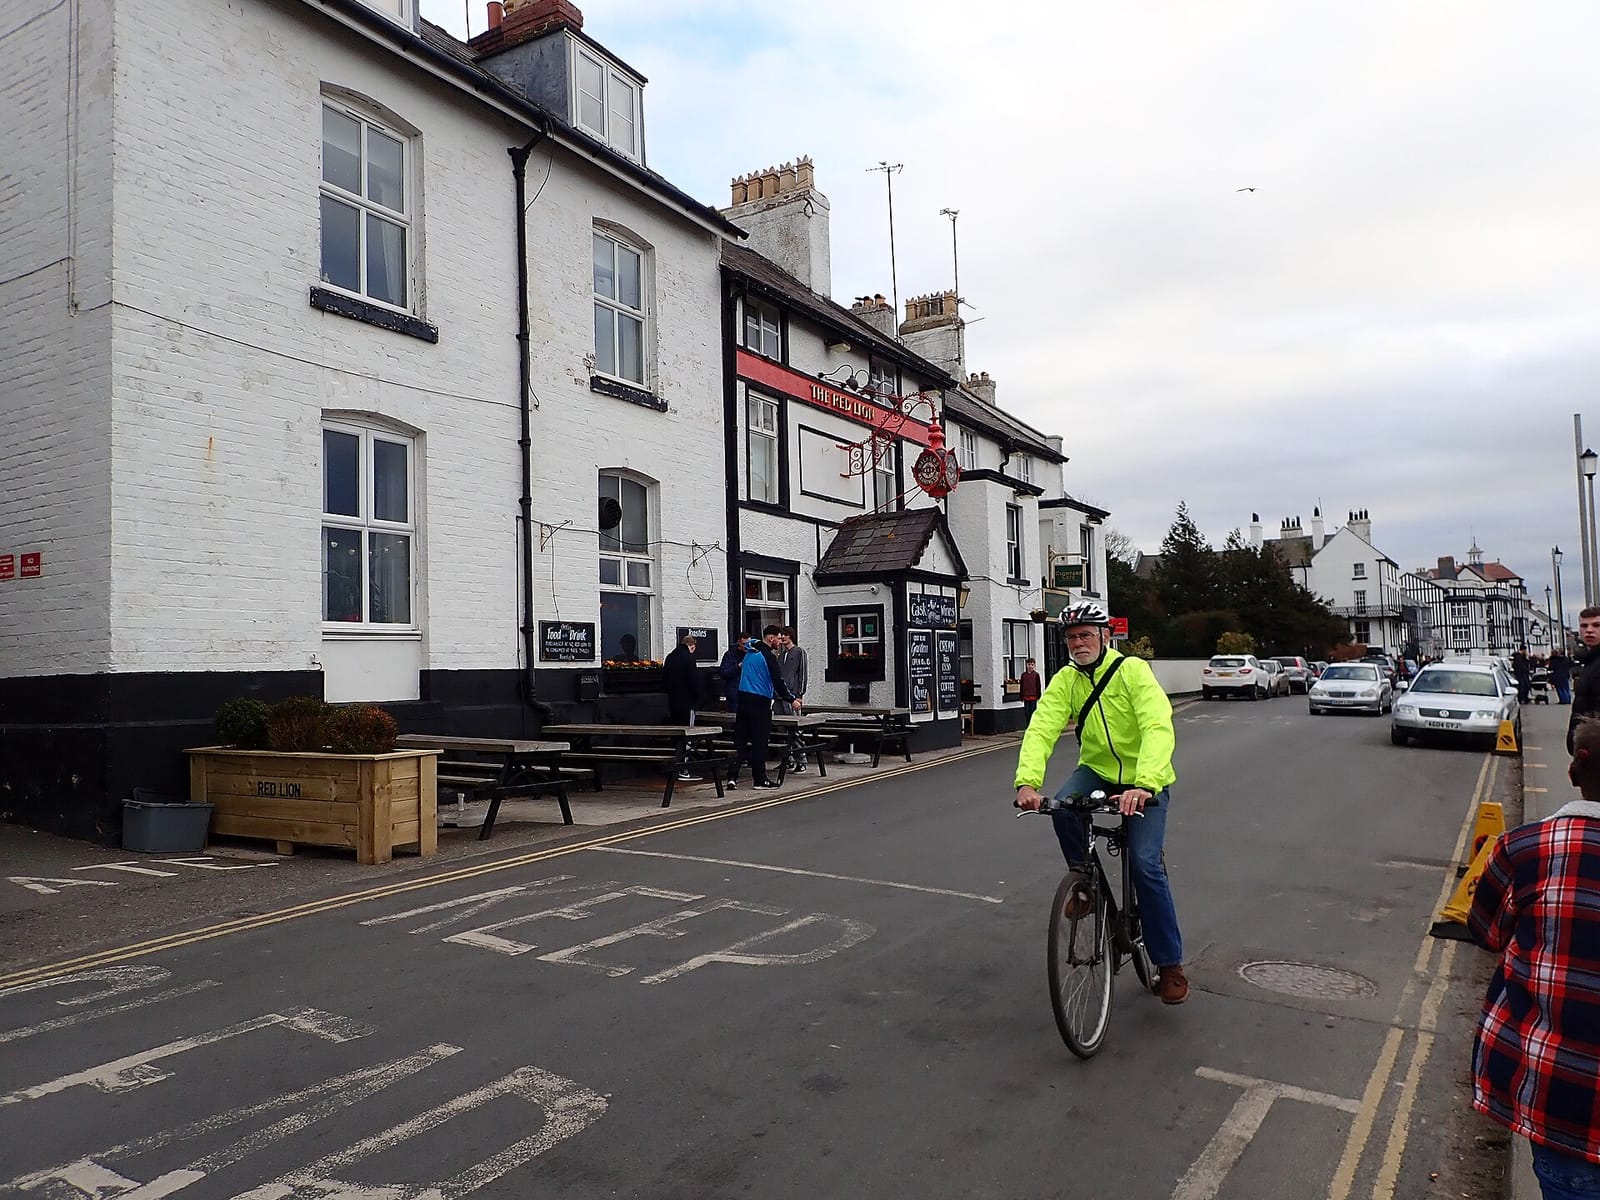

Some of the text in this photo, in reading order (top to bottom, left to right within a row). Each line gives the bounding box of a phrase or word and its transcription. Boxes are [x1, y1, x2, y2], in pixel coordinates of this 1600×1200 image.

[810, 384, 875, 420] THE RED LION
[547, 626, 587, 641] Food Drink
[939, 640, 955, 653] CREAM
[913, 685, 928, 701] Quiz
[940, 682, 955, 692] COFFEE
[257, 781, 301, 798] RED LION
[359, 874, 878, 985] KEEP
